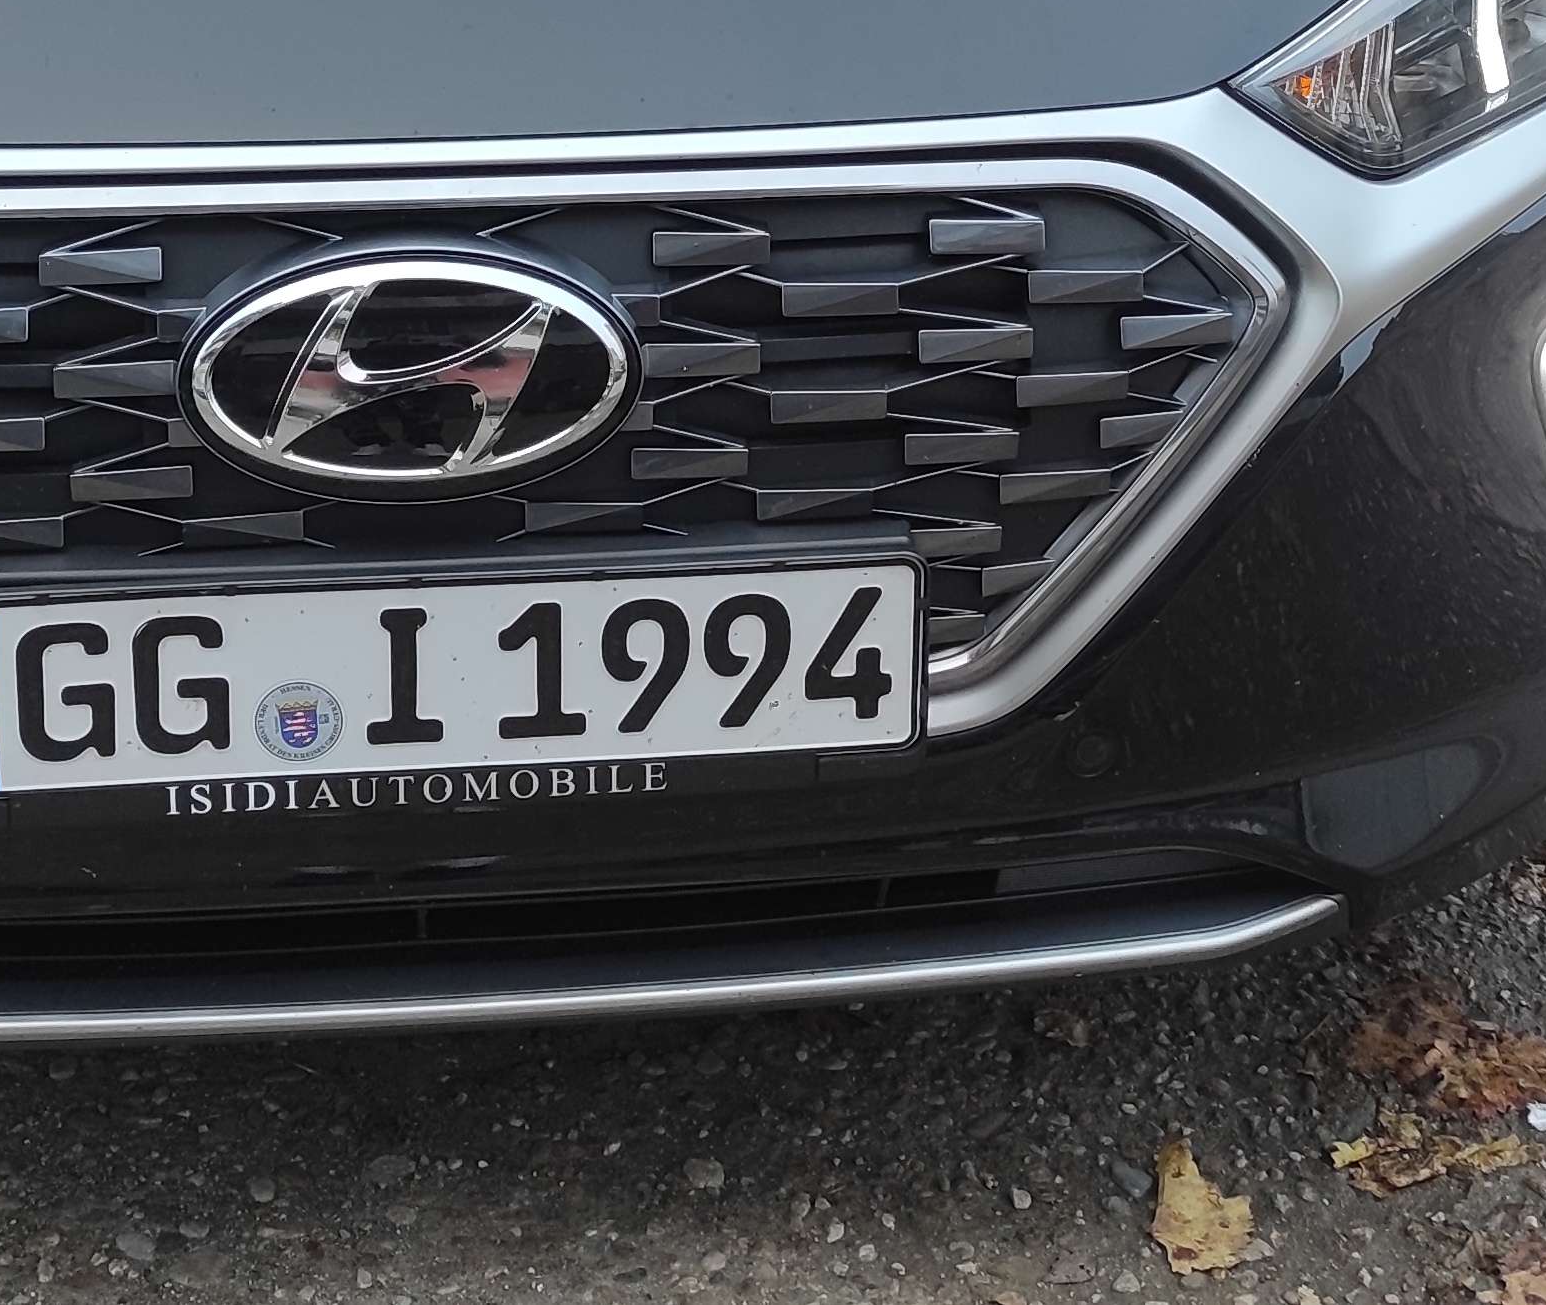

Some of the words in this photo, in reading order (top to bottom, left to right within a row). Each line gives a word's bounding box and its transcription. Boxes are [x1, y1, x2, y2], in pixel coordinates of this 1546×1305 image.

[15, 614, 232, 763] GG
[365, 606, 445, 746] I
[496, 586, 893, 740] 1994
[165, 761, 670, 816] ISIDIAUTOMOBILE
